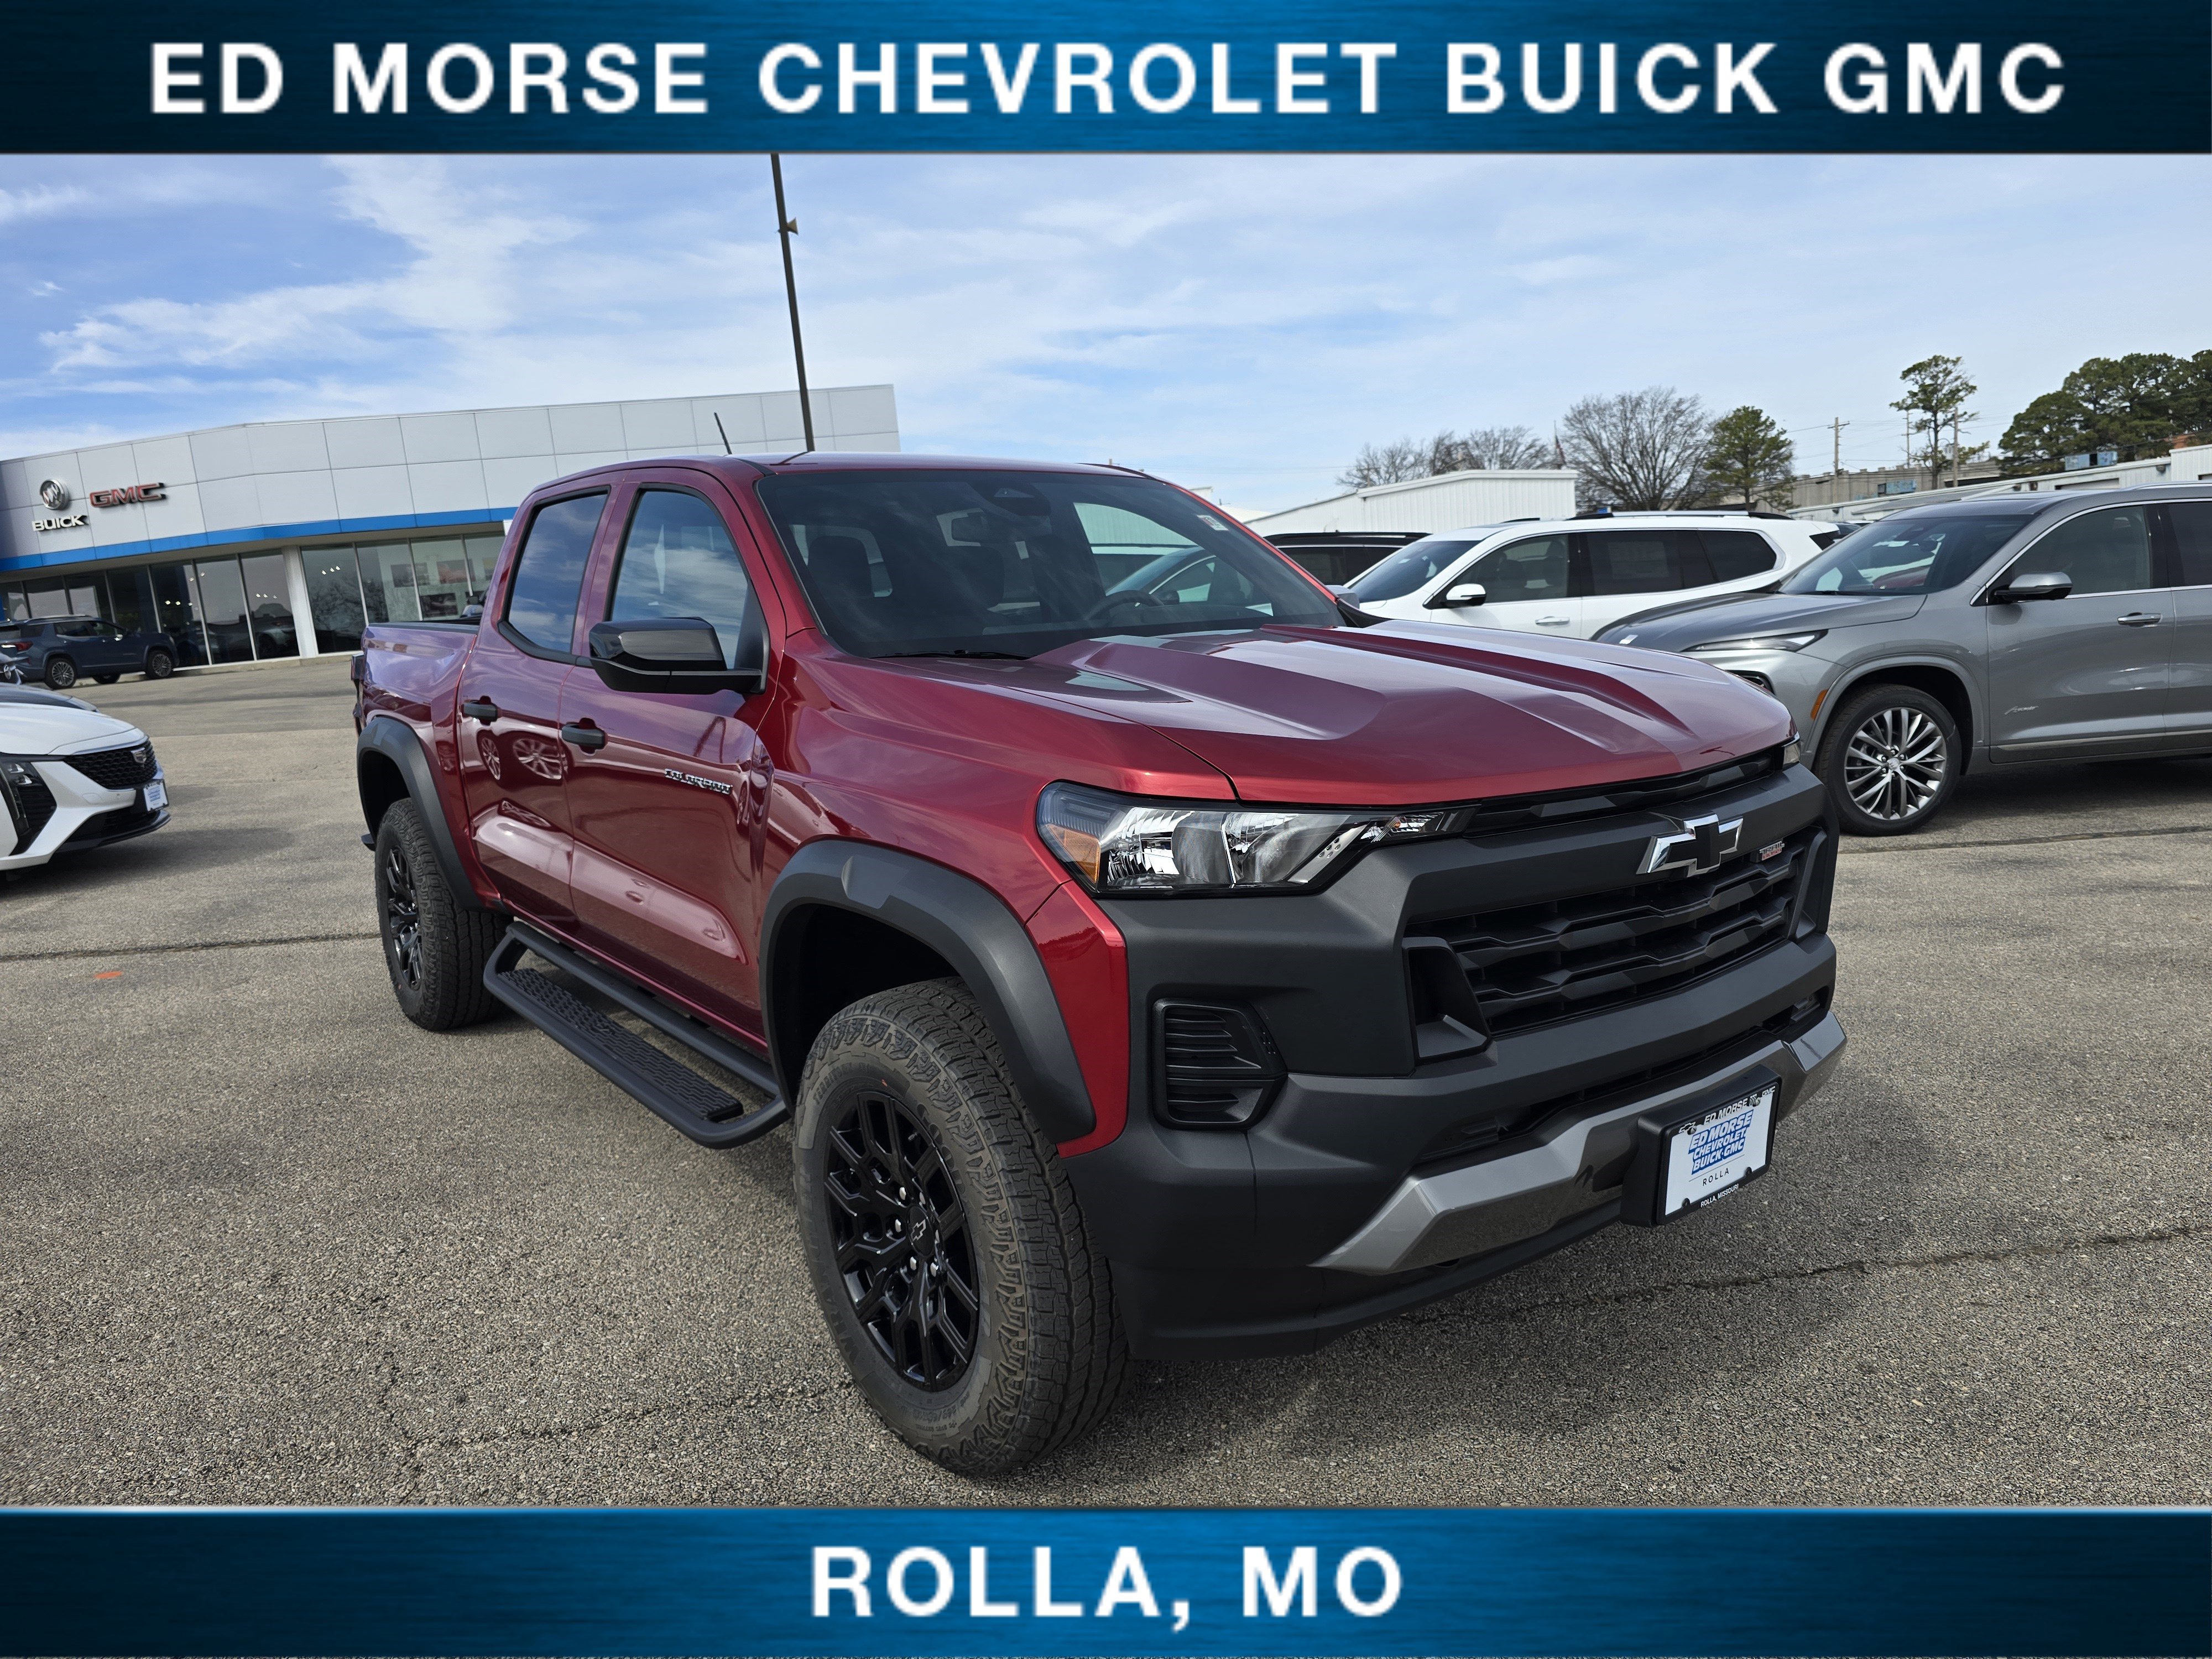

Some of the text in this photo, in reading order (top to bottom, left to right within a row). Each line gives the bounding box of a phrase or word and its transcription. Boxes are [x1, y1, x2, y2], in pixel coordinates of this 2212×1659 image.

[90, 483, 164, 507] GMC
[32, 515, 86, 532] BUICK
[1704, 1098, 1749, 1125] ED MORSE
[1689, 1110, 1754, 1151] ED MORSE
[1694, 1127, 1747, 1160] CHEVROLET
[1703, 1167, 1730, 1187] ROLLA
[1700, 1183, 1740, 1208] ROLLA, MISSOURI
